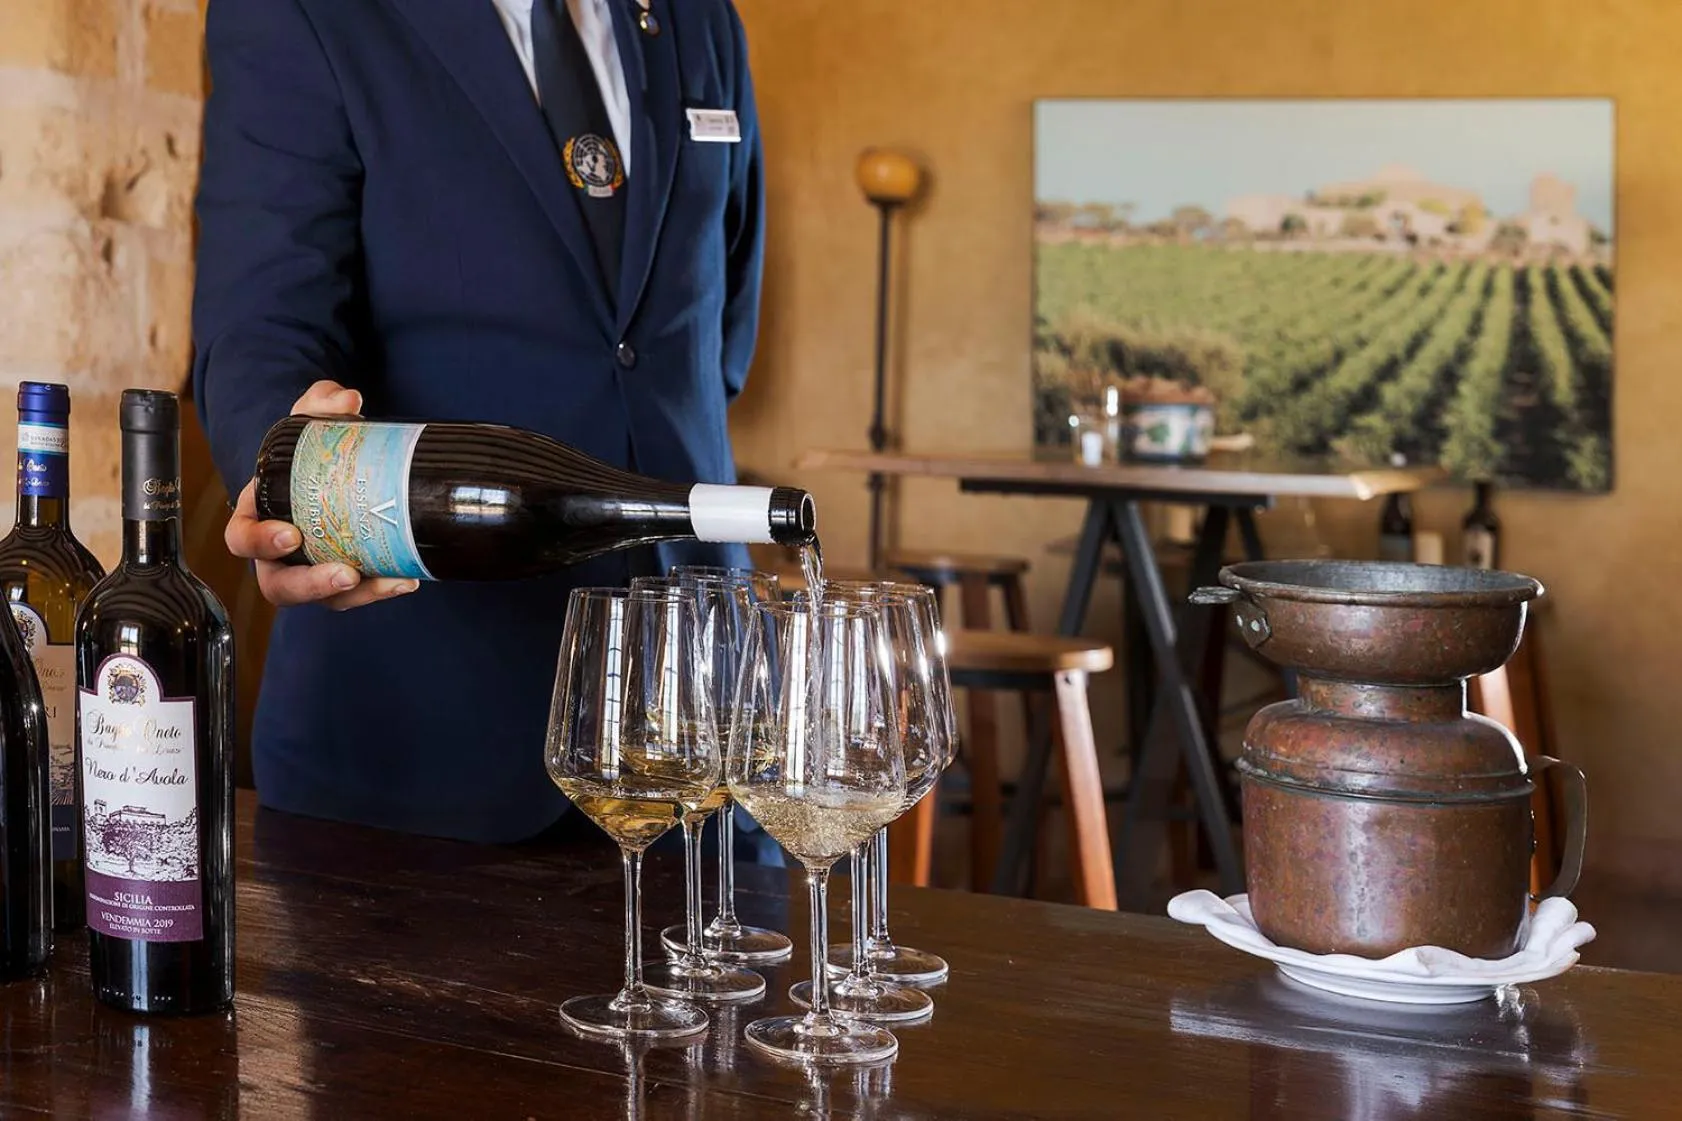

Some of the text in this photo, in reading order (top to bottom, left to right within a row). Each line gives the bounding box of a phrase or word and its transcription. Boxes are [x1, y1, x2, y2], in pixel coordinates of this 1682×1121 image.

[307, 475, 325, 538] ZIBIBBO
[357, 478, 372, 541] ESSENZA
[369, 499, 399, 527] V
[85, 757, 116, 780] Nero
[113, 891, 153, 905] SICILIA
[101, 912, 174, 928] VENDEMMIA 2019
[109, 922, 132, 933] ELEVATO
[141, 927, 161, 935] BOTTE
